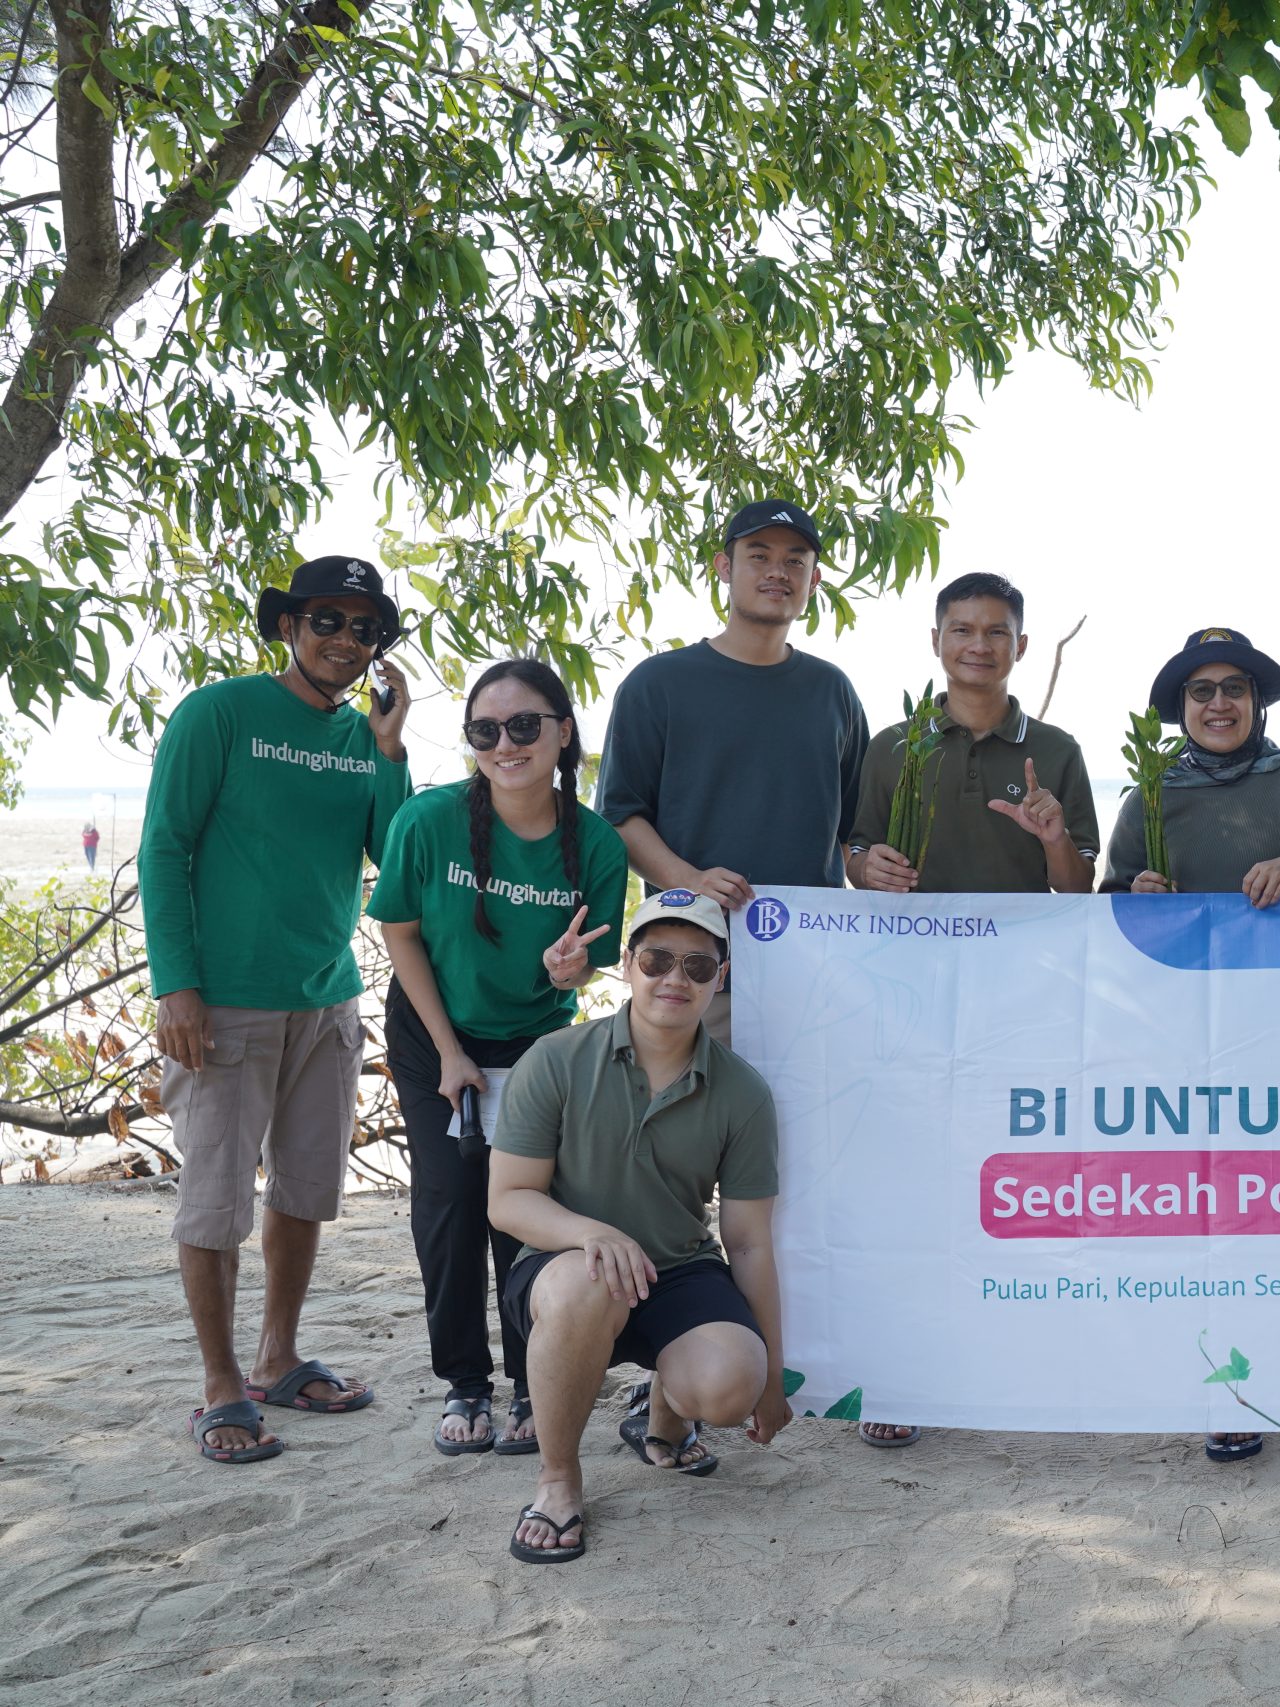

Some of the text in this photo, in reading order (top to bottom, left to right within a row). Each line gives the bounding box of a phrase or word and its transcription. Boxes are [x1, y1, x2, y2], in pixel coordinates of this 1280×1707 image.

[252, 737, 377, 775] lindungihutan
[799, 912, 999, 937] BANK INDONESIA
[1009, 1087, 1067, 1137] BI
[992, 1171, 1217, 1219] Sedekah
[982, 1278, 1047, 1301] Pulau
[1056, 1277, 1108, 1303] Pari,
[1117, 1275, 1246, 1304] Kepulauan
